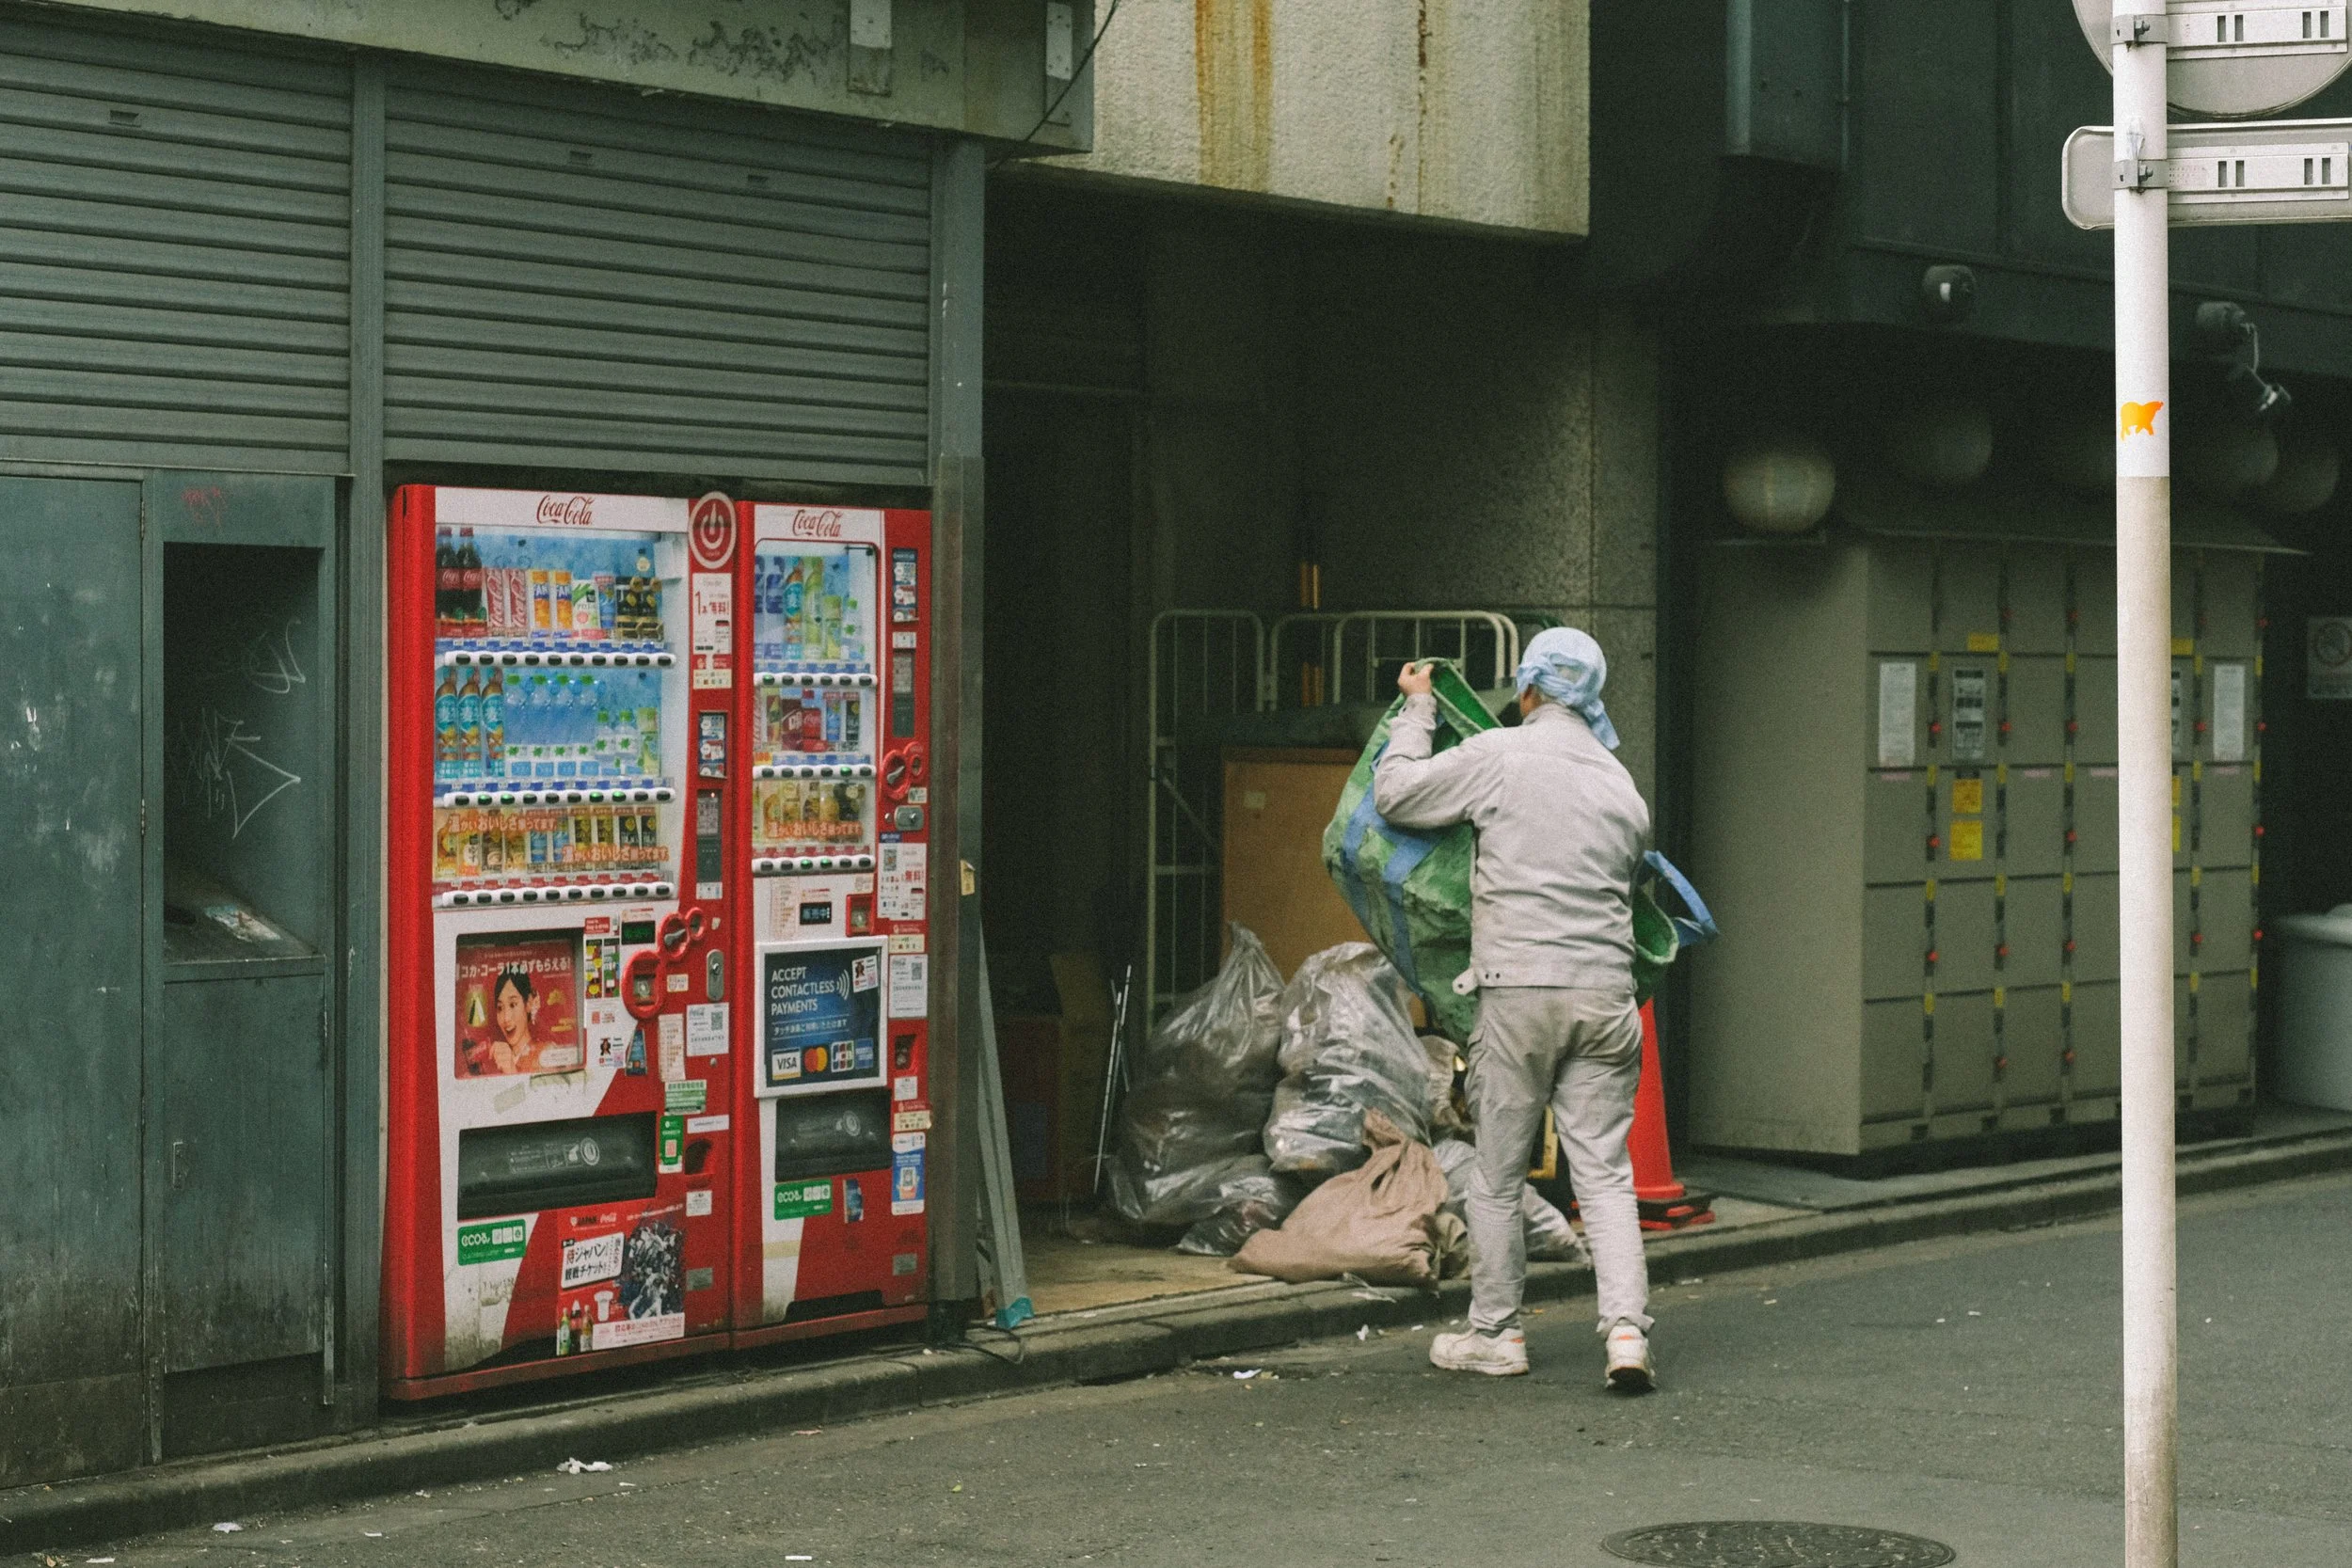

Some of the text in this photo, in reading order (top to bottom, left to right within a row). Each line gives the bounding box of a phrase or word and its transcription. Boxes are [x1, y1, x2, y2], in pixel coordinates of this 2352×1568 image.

[536, 495, 595, 525] Coca-Cola
[792, 509, 844, 538] Coca-Cola
[771, 967, 806, 982] ACCEPT
[771, 980, 834, 999] CONTACTLESS
[771, 999, 818, 1016] PAYMENTS
[777, 1056, 798, 1070] VISA
